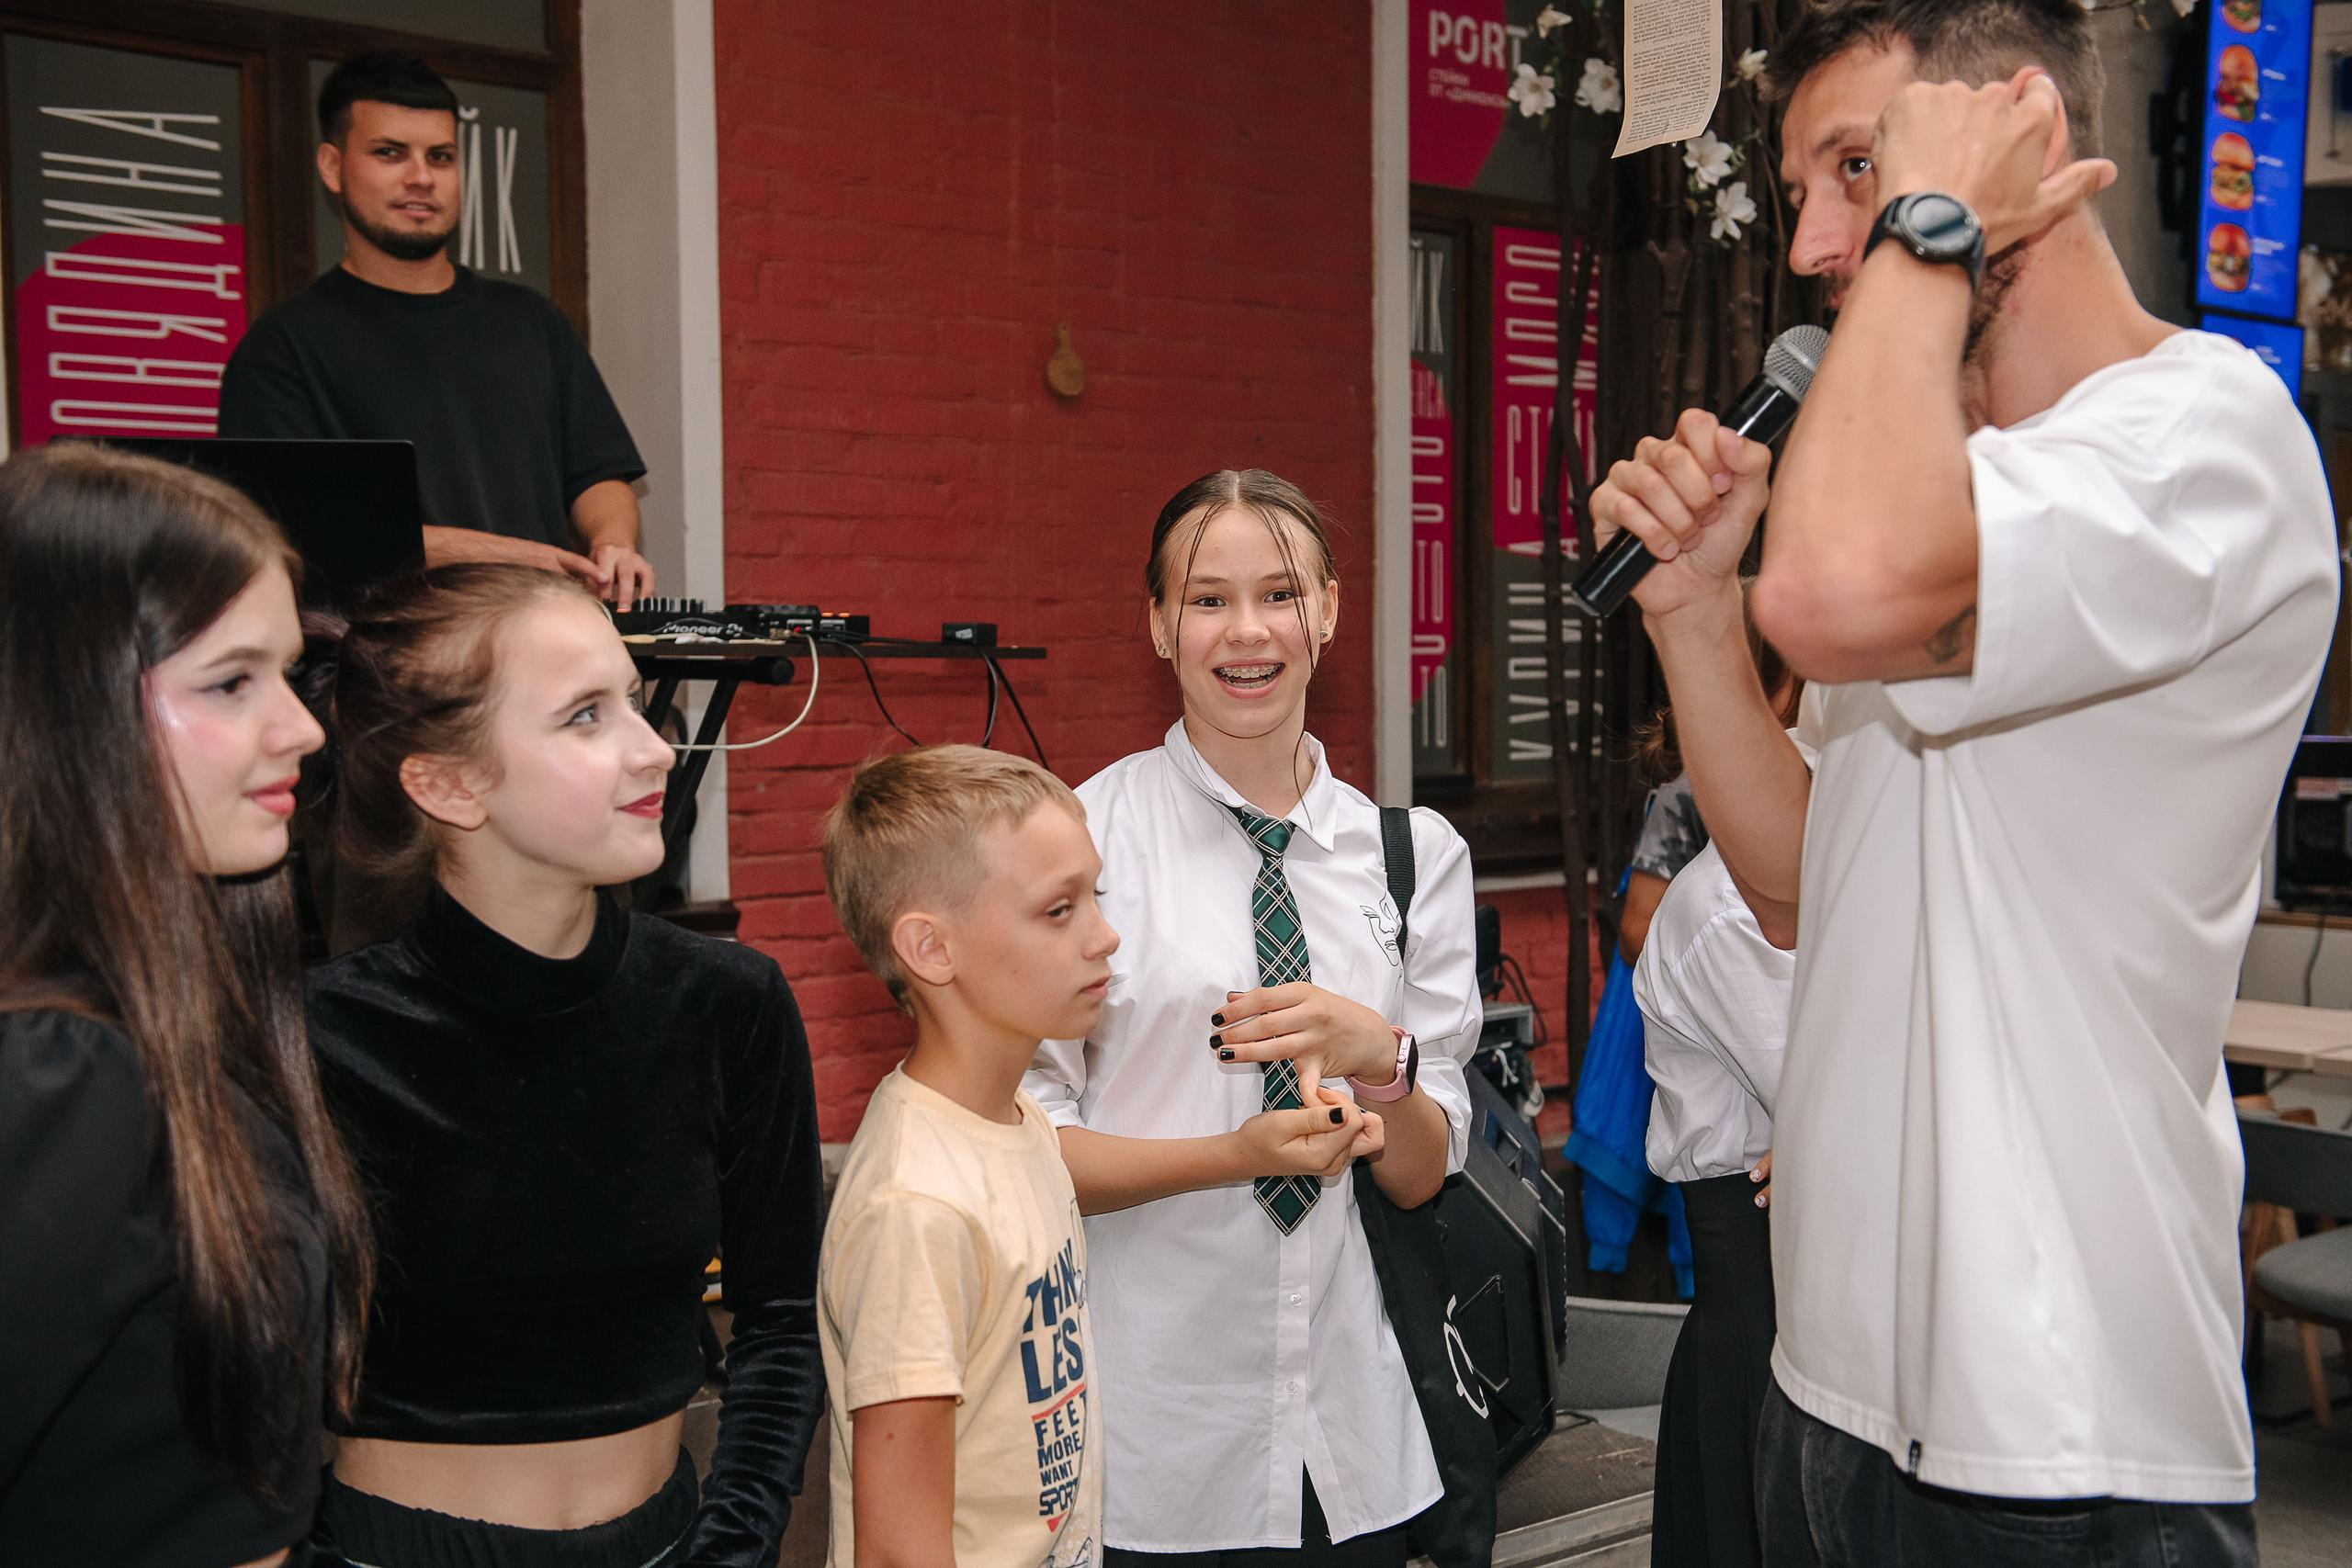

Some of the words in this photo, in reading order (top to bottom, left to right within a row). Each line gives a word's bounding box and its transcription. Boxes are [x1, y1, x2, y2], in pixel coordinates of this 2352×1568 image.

[1428, 9, 1528, 71] PORT
[1037, 1431, 1083, 1469] MORE
[1040, 1461, 1074, 1487] WANT
